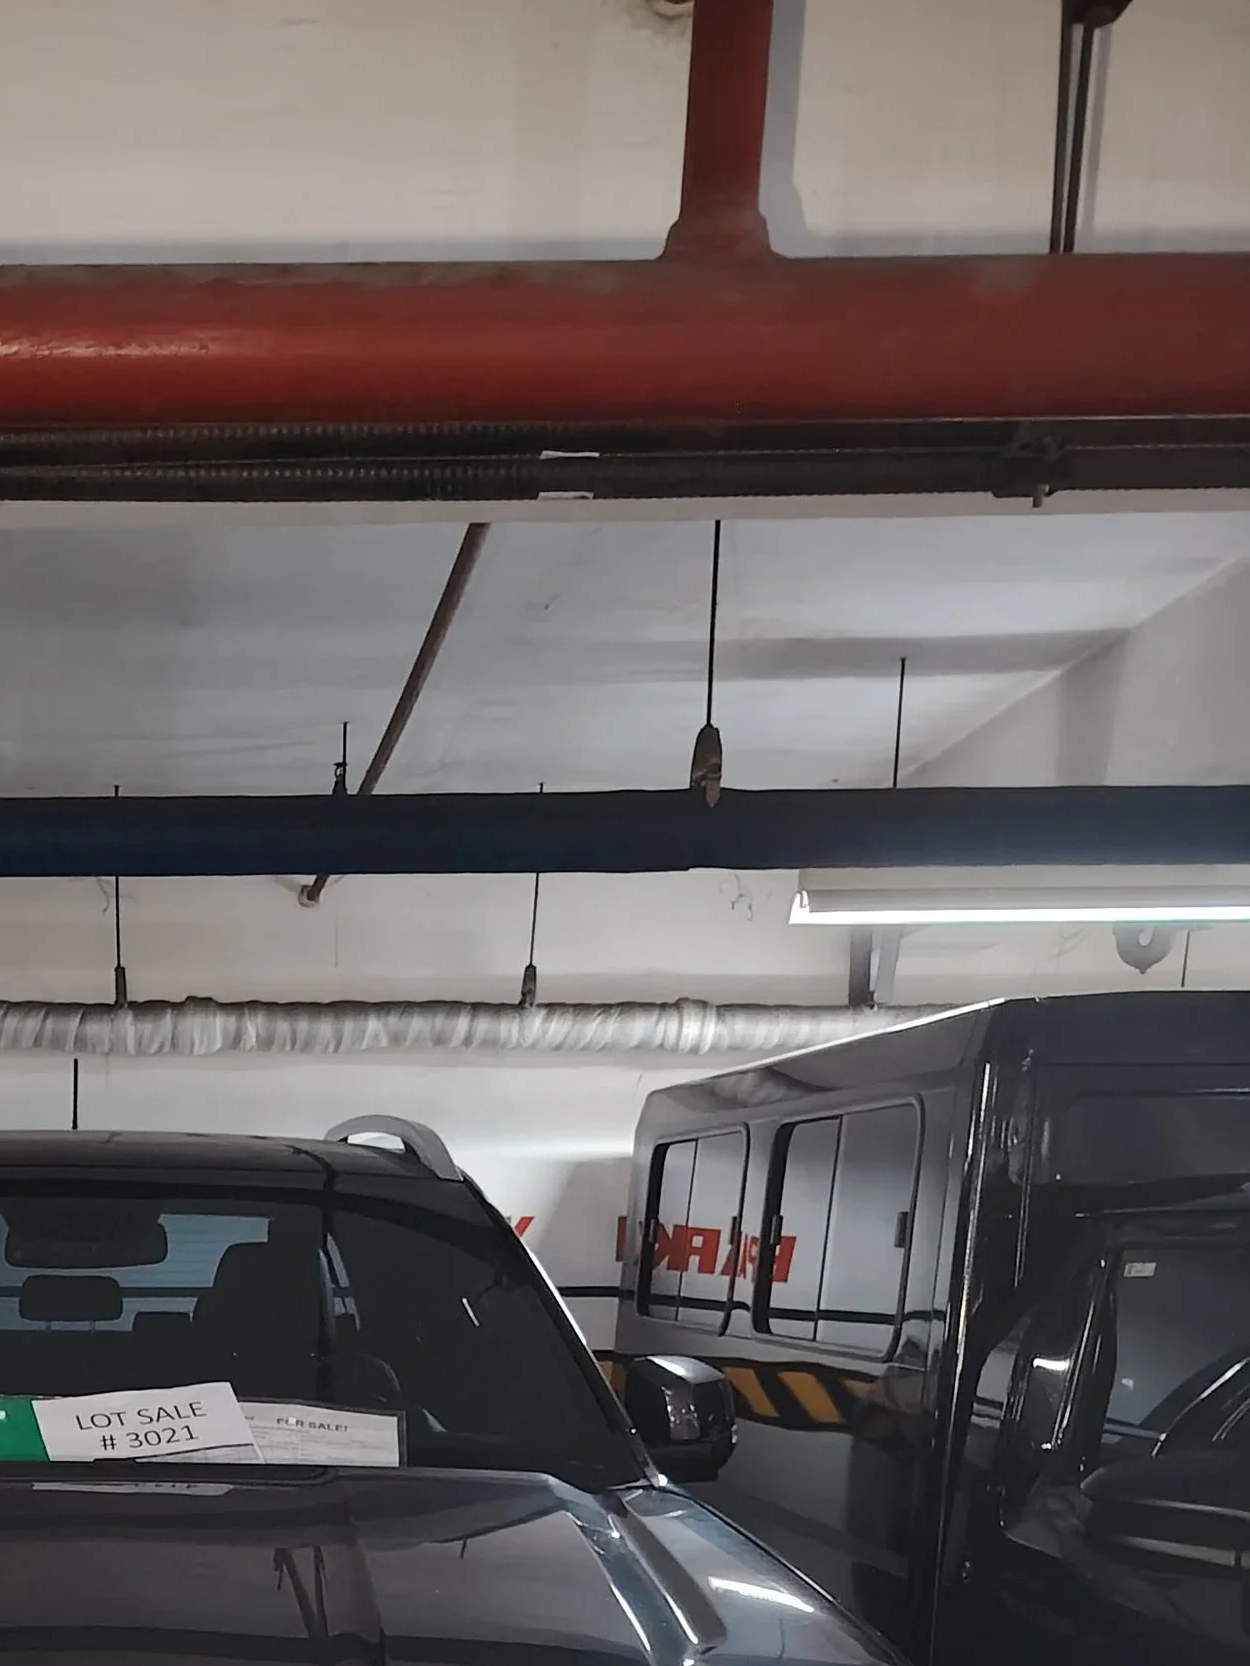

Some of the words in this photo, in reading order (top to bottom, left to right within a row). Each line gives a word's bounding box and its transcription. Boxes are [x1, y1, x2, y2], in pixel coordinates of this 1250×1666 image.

[75, 1411, 127, 1431] LOT
[137, 1401, 207, 1426] SALE
[100, 1433, 117, 1451] #
[125, 1424, 199, 1449] 3021
